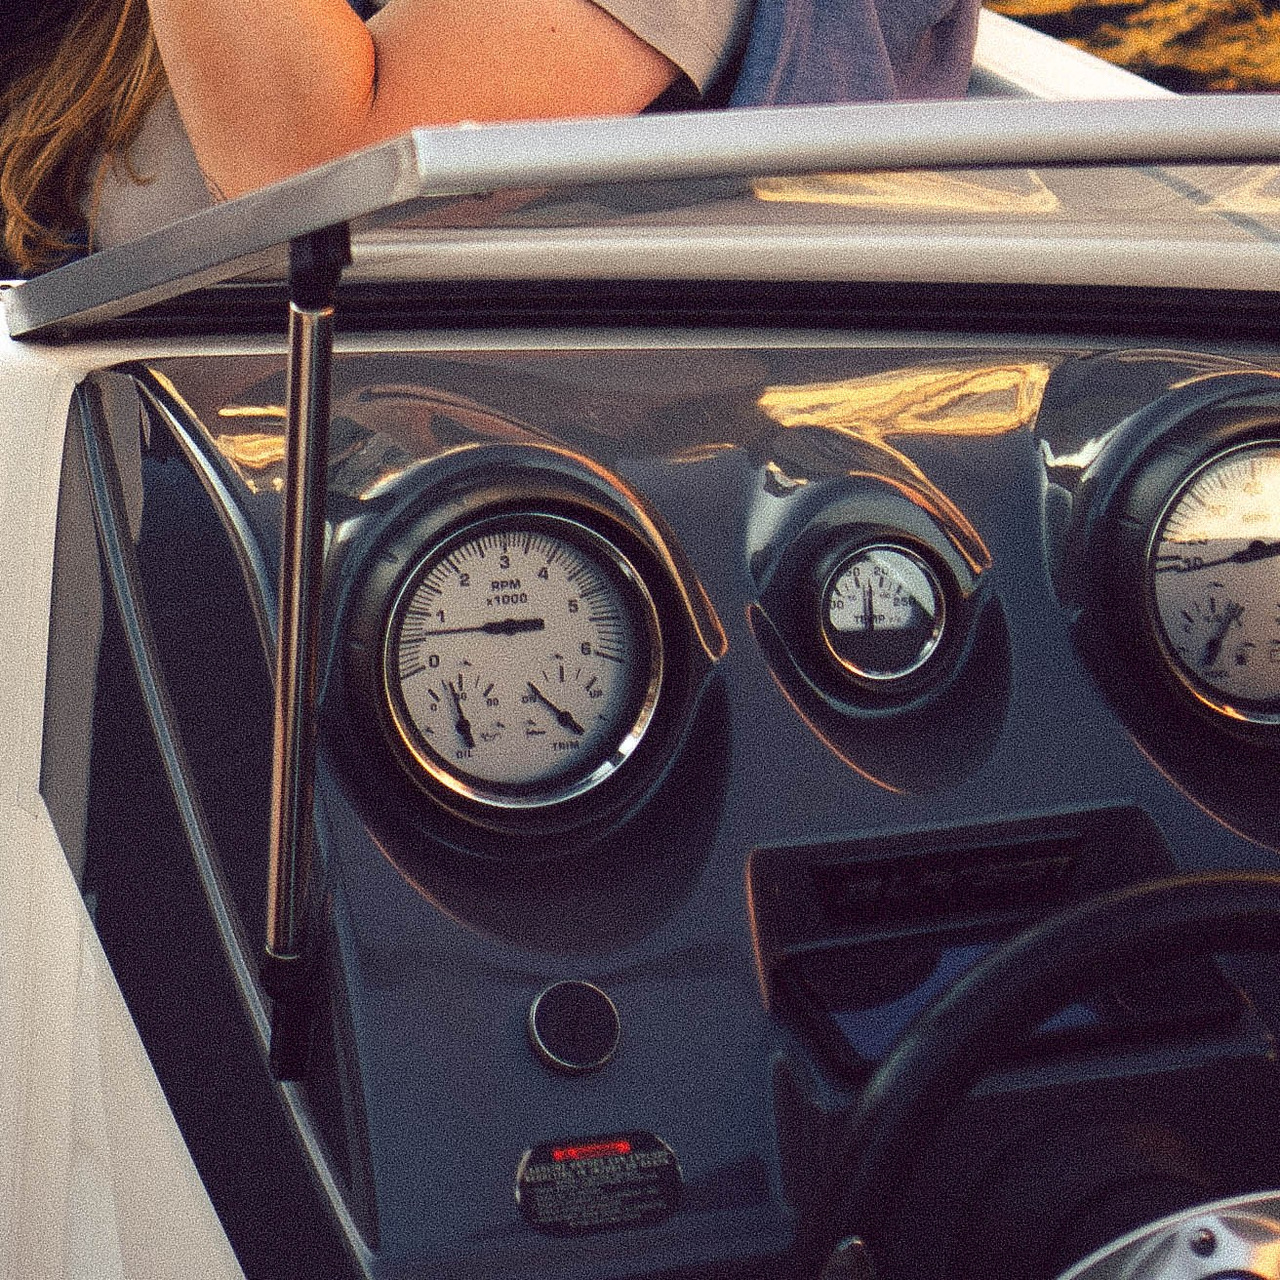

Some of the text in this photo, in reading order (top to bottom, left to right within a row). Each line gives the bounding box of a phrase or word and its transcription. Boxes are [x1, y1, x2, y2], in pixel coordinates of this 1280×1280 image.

[499, 555, 510, 569] 3
[459, 573, 470, 586] 2
[537, 567, 549, 580] 4
[490, 578, 521, 591] RPM
[486, 592, 528, 607] x1000
[568, 599, 578, 613] 5
[436, 609, 446, 622] 1
[581, 642, 591, 655] 6
[429, 654, 439, 668] 0
